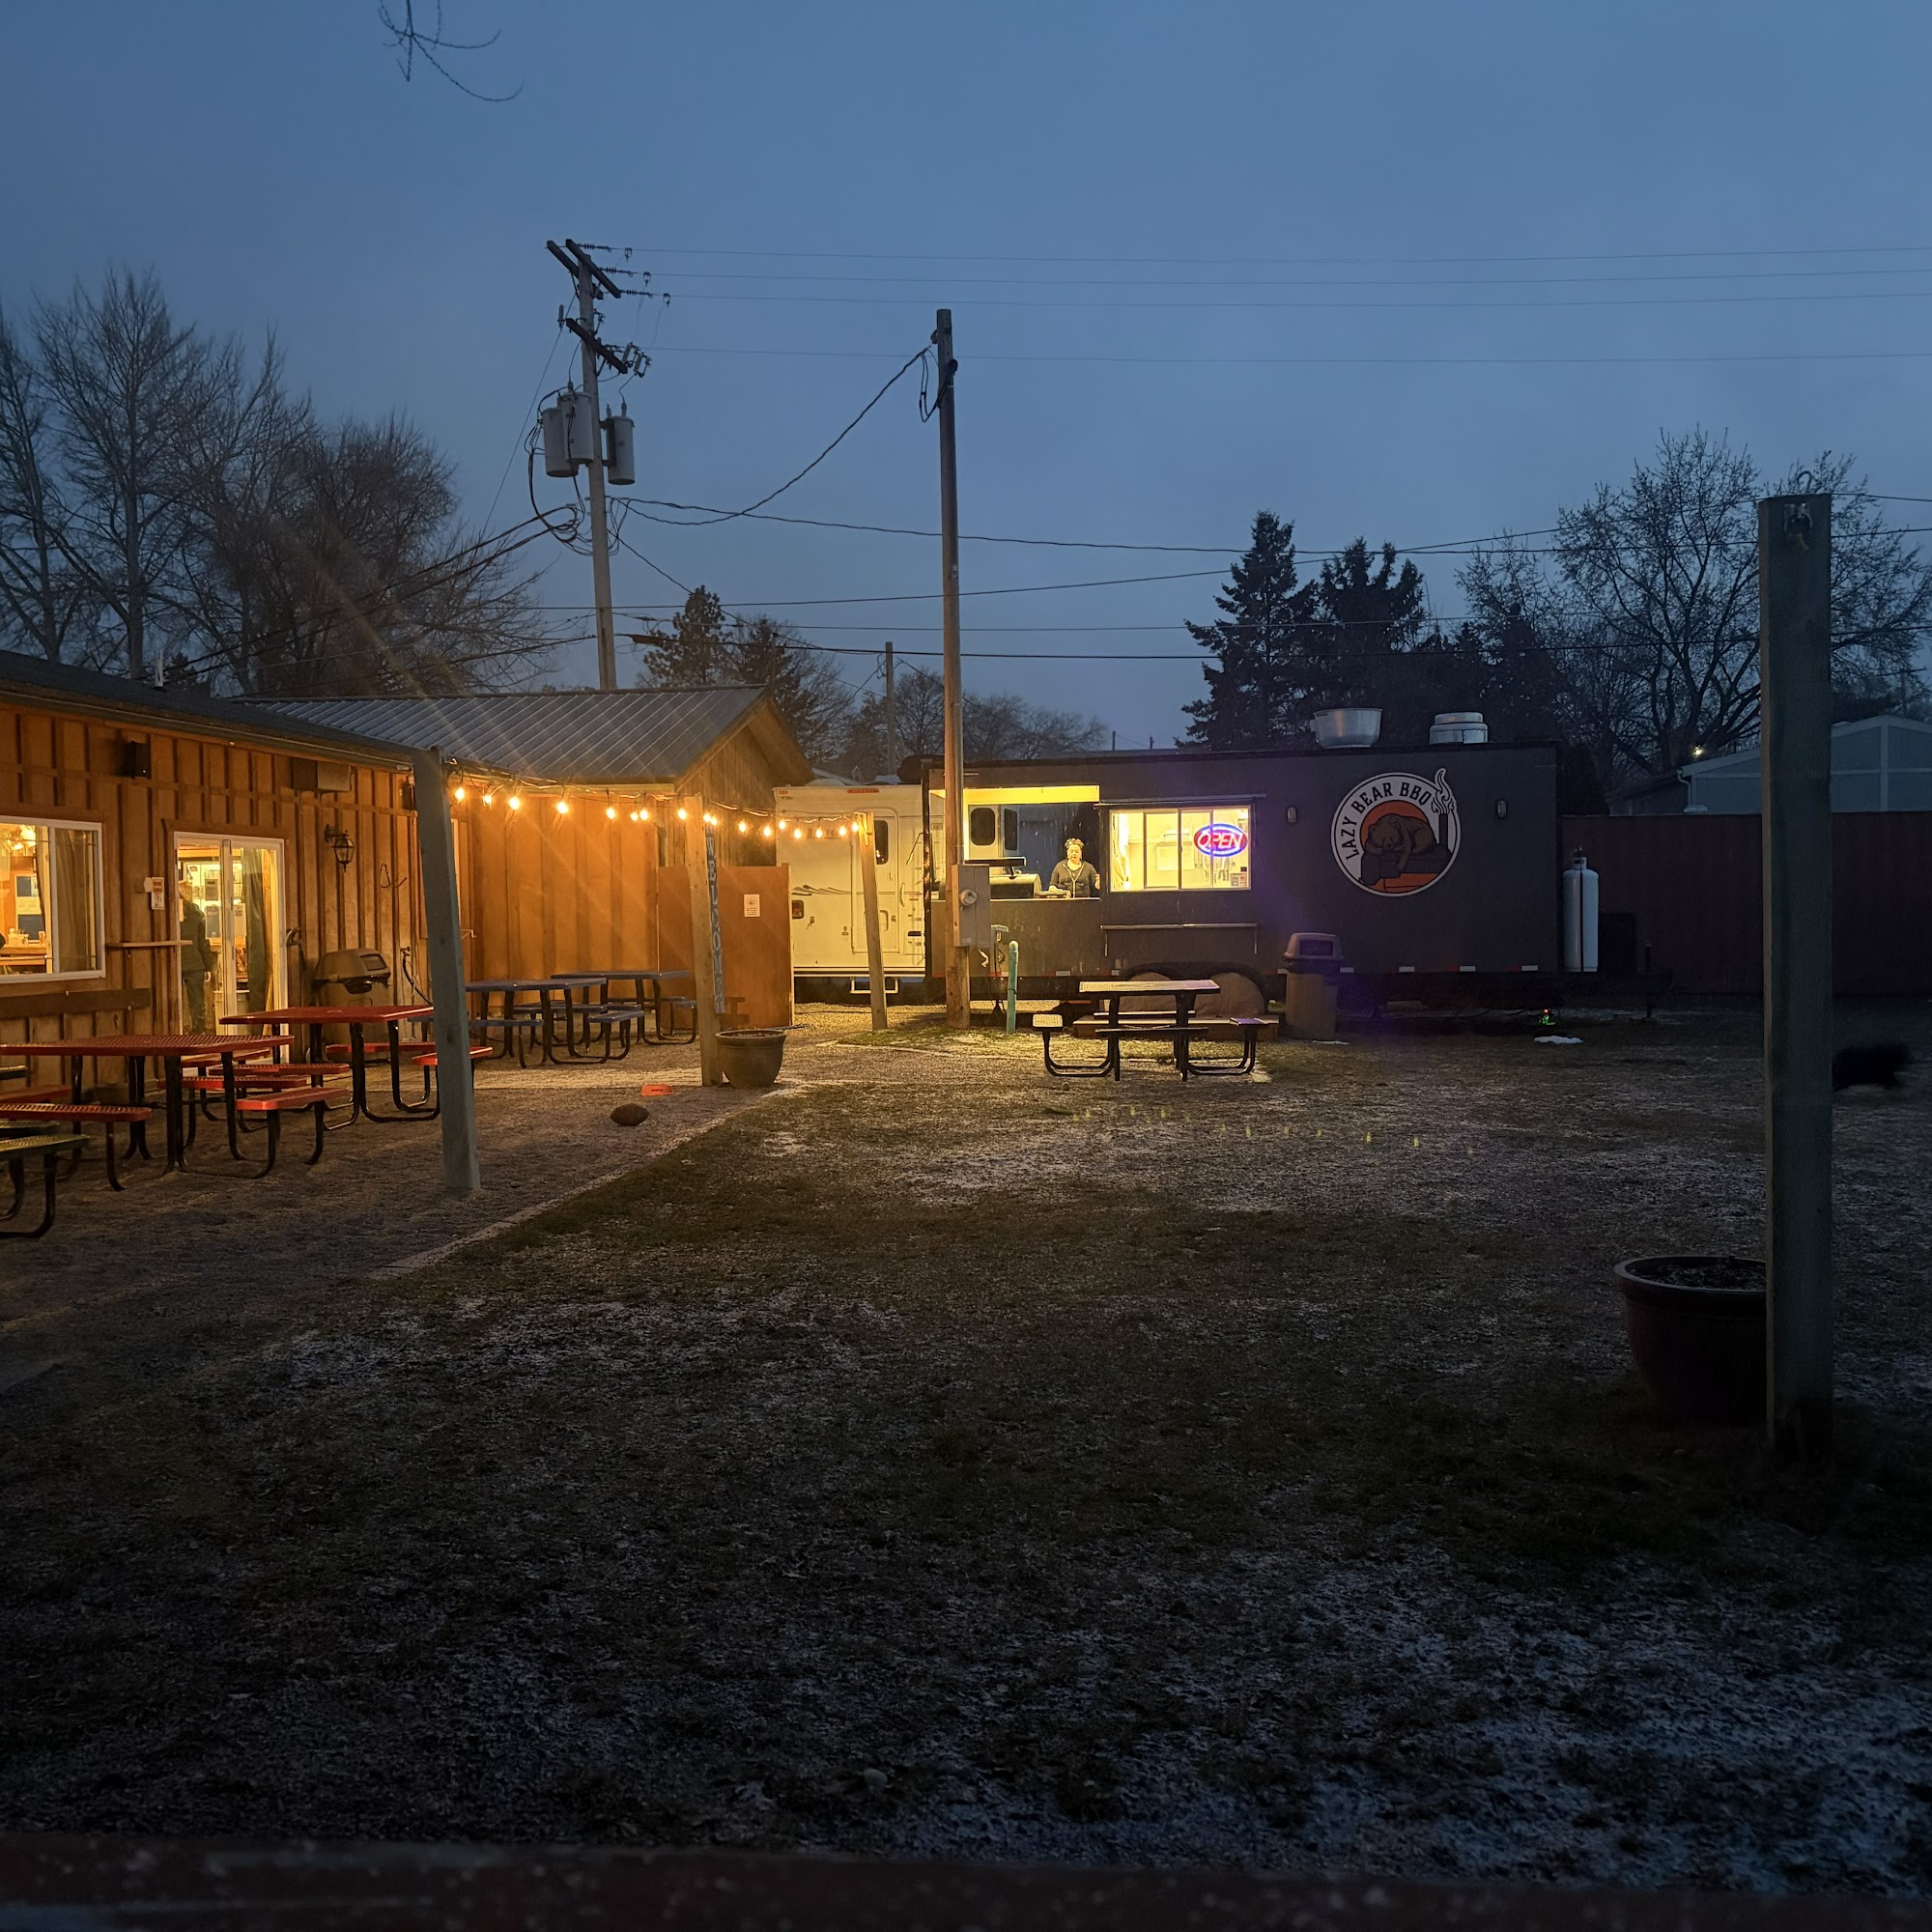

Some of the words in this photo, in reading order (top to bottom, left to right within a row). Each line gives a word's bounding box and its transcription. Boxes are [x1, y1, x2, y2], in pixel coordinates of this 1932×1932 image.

[1198, 832, 1243, 849] OPEN
[1341, 816, 1360, 860] LAZY
[1351, 782, 1393, 813] BEAR
[1400, 782, 1432, 806] BBQ
